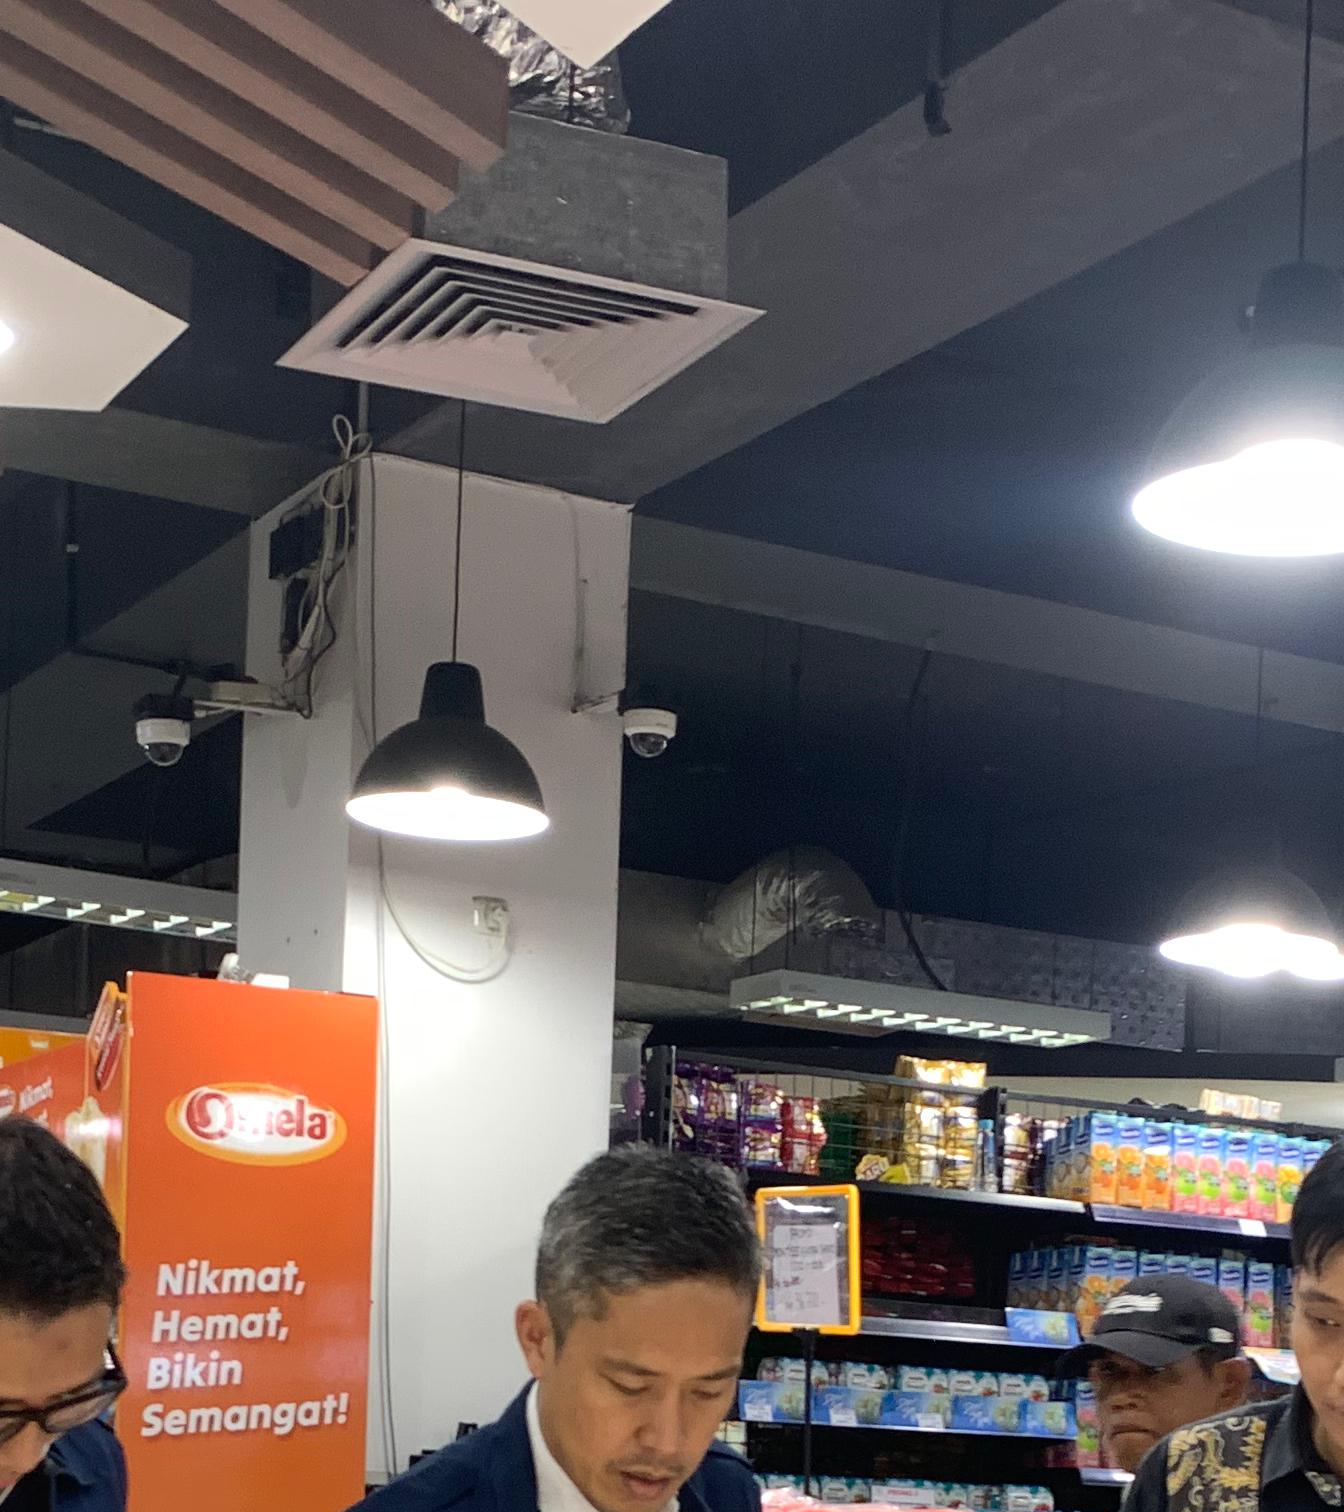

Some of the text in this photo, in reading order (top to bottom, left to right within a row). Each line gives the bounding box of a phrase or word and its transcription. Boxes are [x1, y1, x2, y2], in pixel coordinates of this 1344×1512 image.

[186, 1091, 328, 1140] Oela
[157, 1258, 306, 1297] Nikmat,
[152, 1309, 289, 1343] Hemat,
[147, 1354, 242, 1390] Bikin
[141, 1393, 349, 1437] Semangat!
